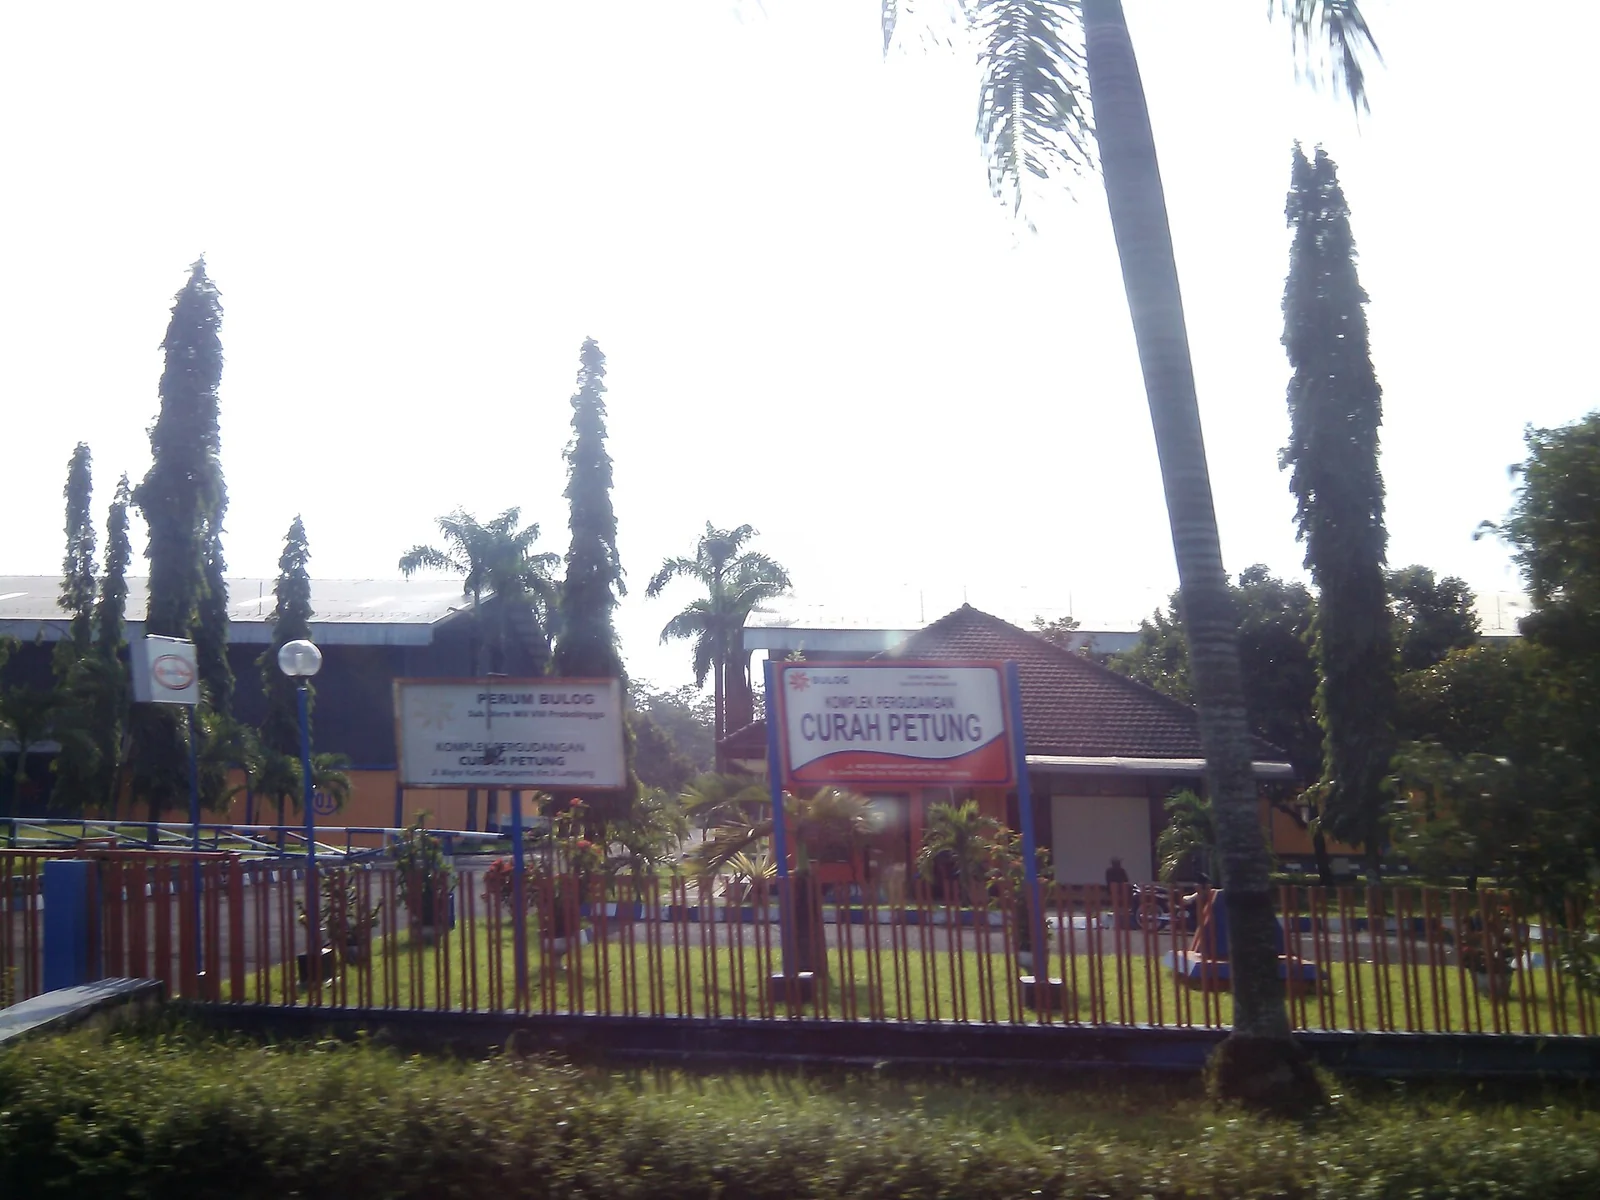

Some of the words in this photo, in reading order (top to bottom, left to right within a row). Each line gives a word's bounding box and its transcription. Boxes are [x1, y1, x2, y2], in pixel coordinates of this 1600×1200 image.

[813, 675, 848, 685] BULOG
[477, 693, 534, 705] PERUM
[539, 693, 595, 705] BULOG
[826, 696, 873, 709] KOMPLEK
[877, 696, 955, 709] PERGUDANGAN
[801, 713, 881, 742] CURAH
[888, 713, 981, 742] PETUNG
[509, 756, 566, 767] PETUNG
